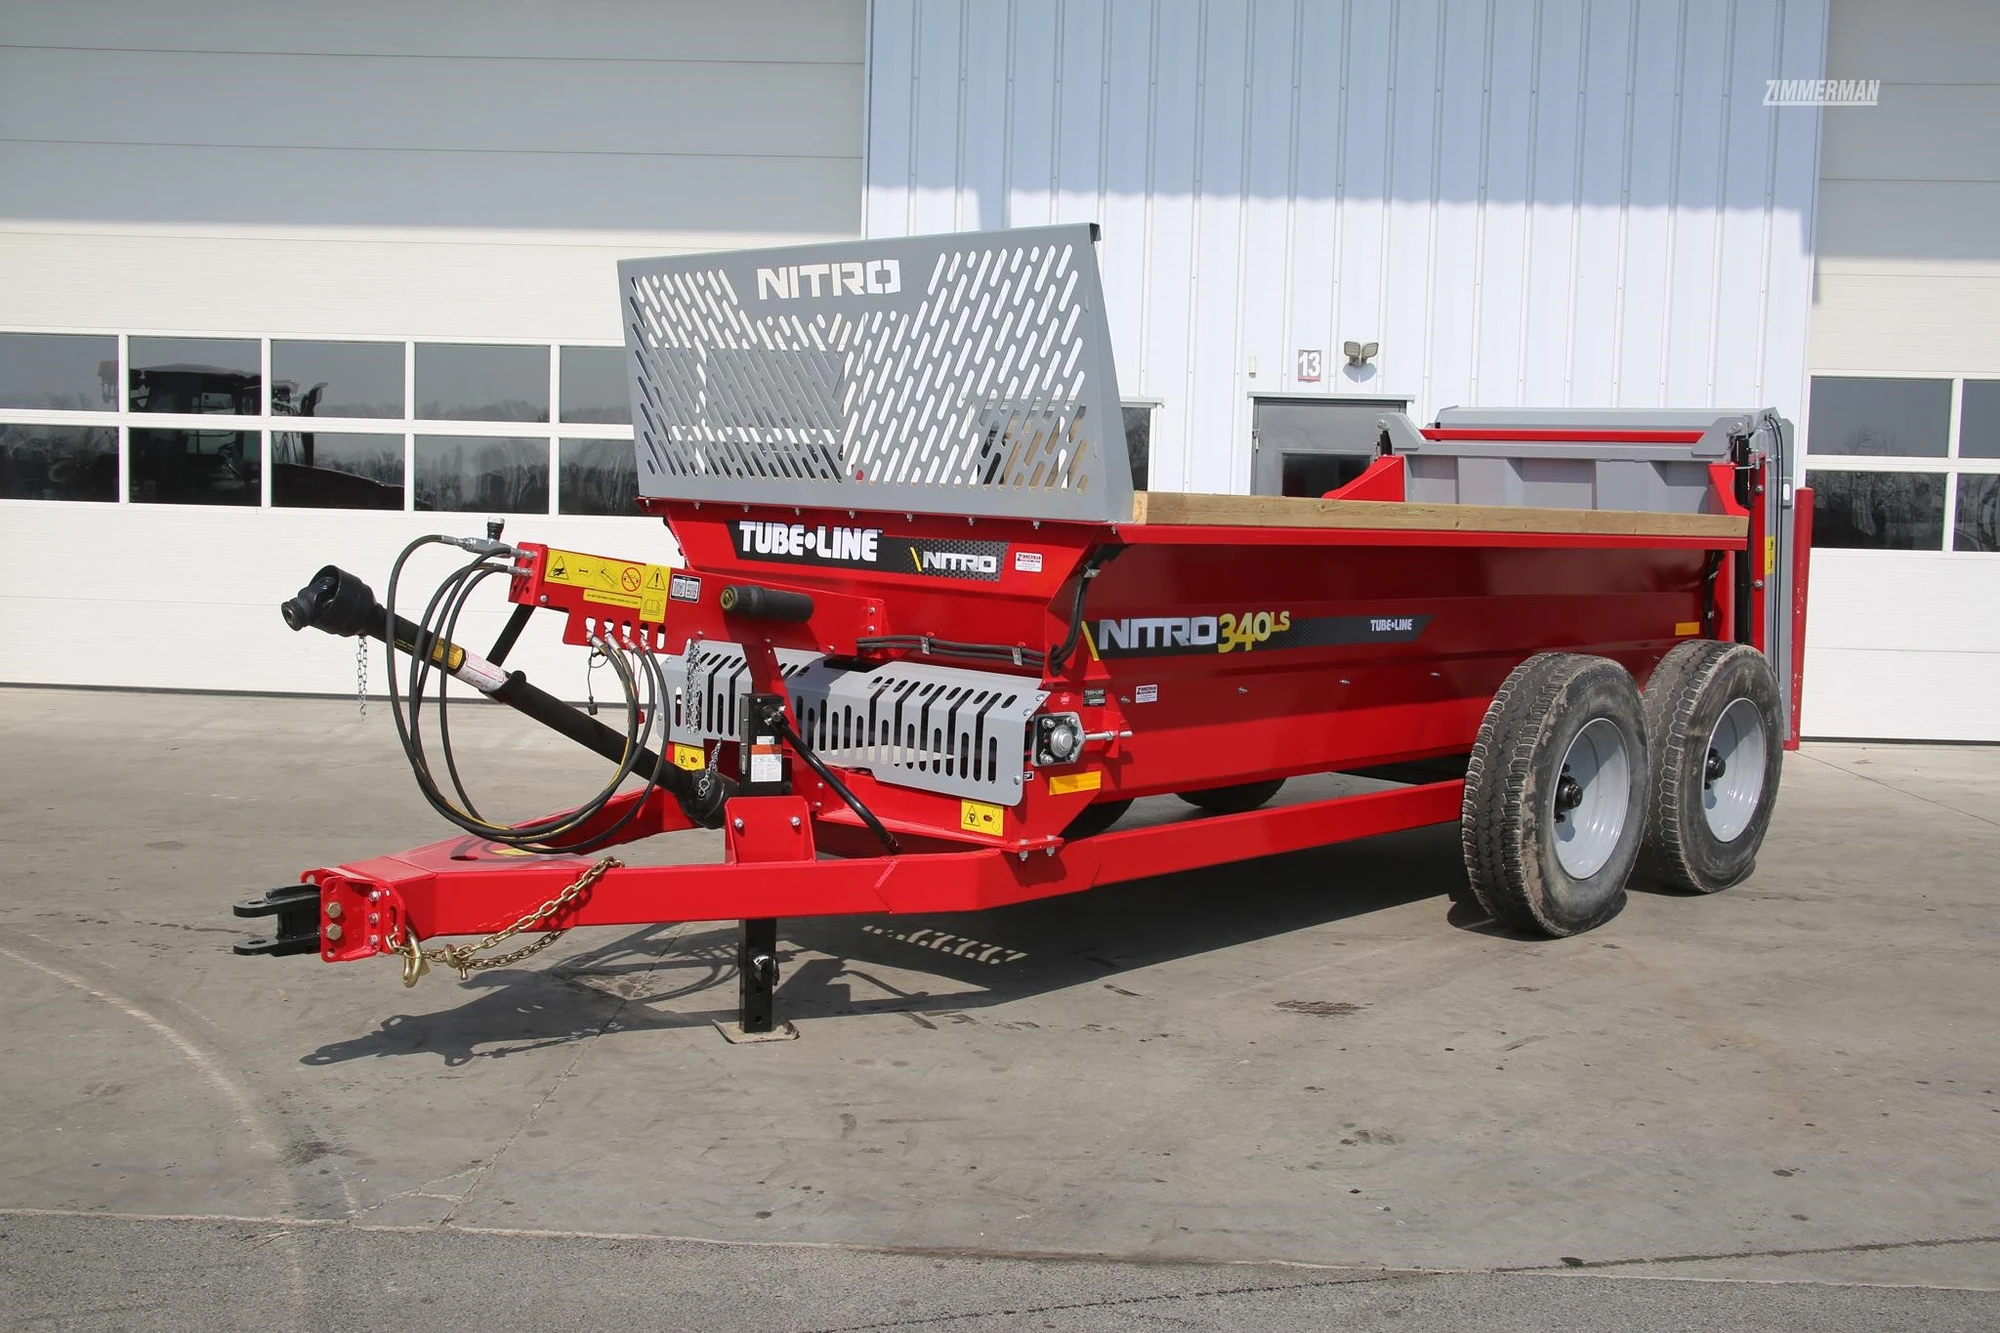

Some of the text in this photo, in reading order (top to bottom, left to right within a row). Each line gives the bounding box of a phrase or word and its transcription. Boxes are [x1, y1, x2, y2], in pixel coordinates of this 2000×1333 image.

[757, 259, 901, 300] NITRO
[1299, 351, 1321, 377] 13
[922, 551, 997, 573] NITRO
[1099, 616, 1218, 650] NITRO
